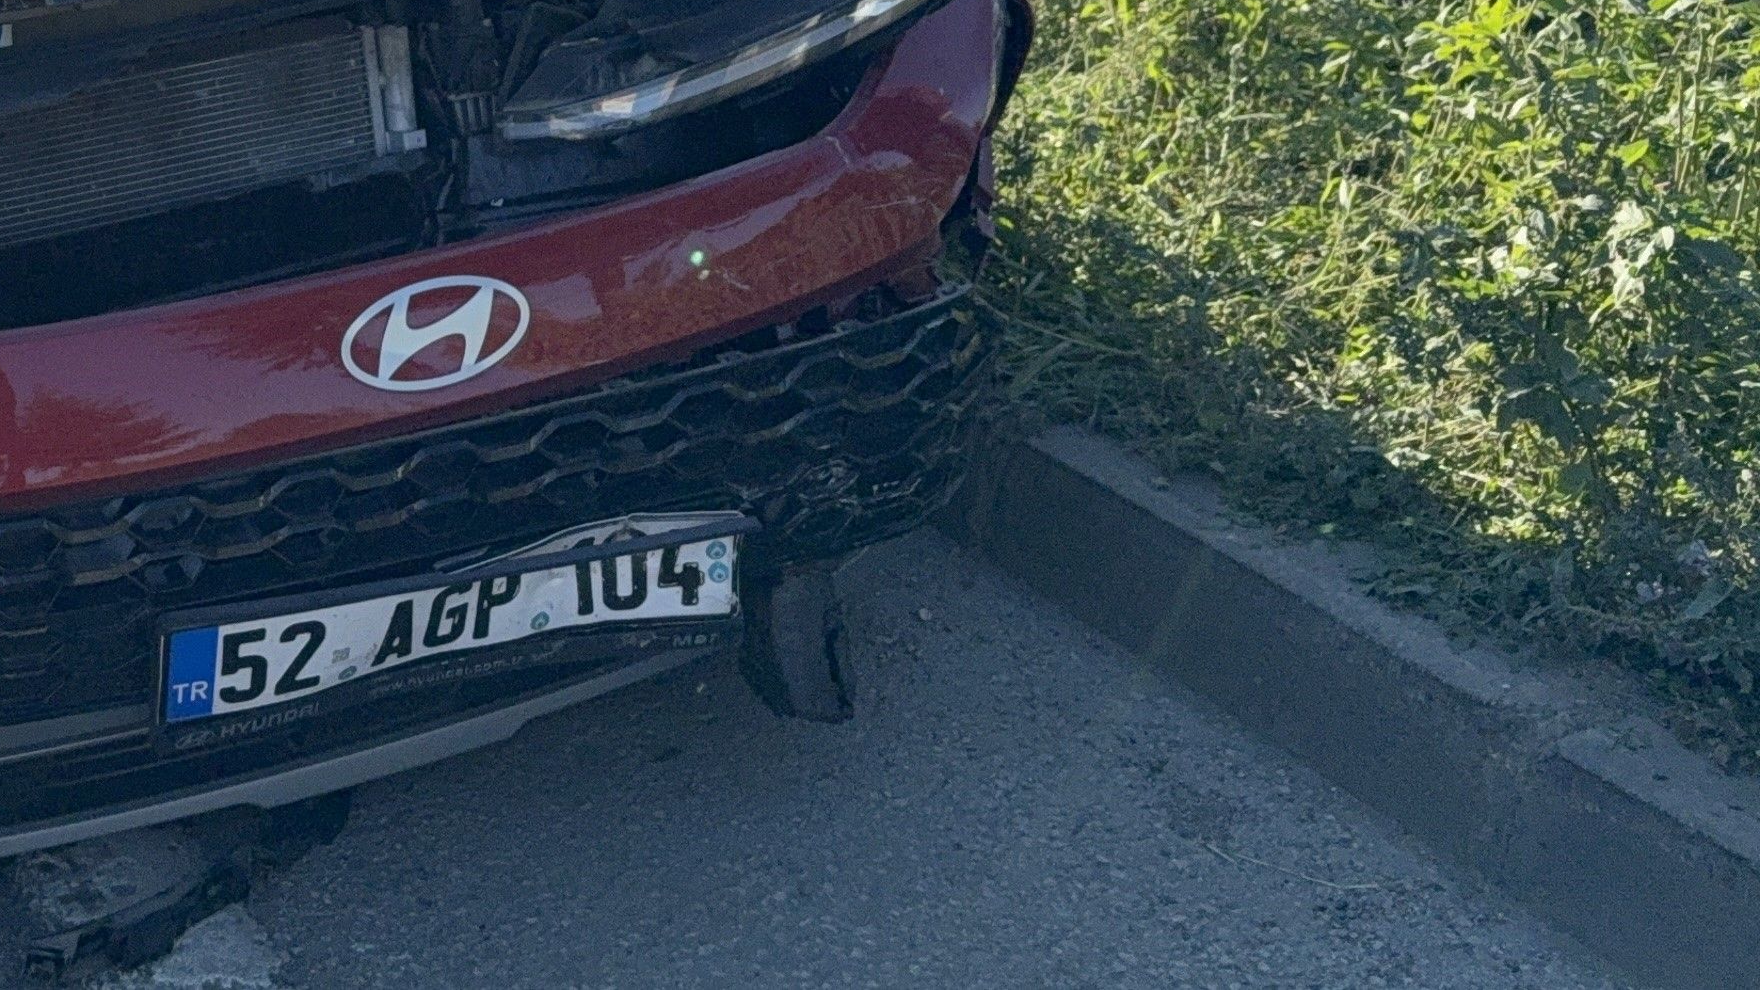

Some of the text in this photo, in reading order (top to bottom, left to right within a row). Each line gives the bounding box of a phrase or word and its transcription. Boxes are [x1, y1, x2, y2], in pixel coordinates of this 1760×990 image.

[219, 526, 706, 704] 52 AGP 104
[172, 680, 209, 704] TR
